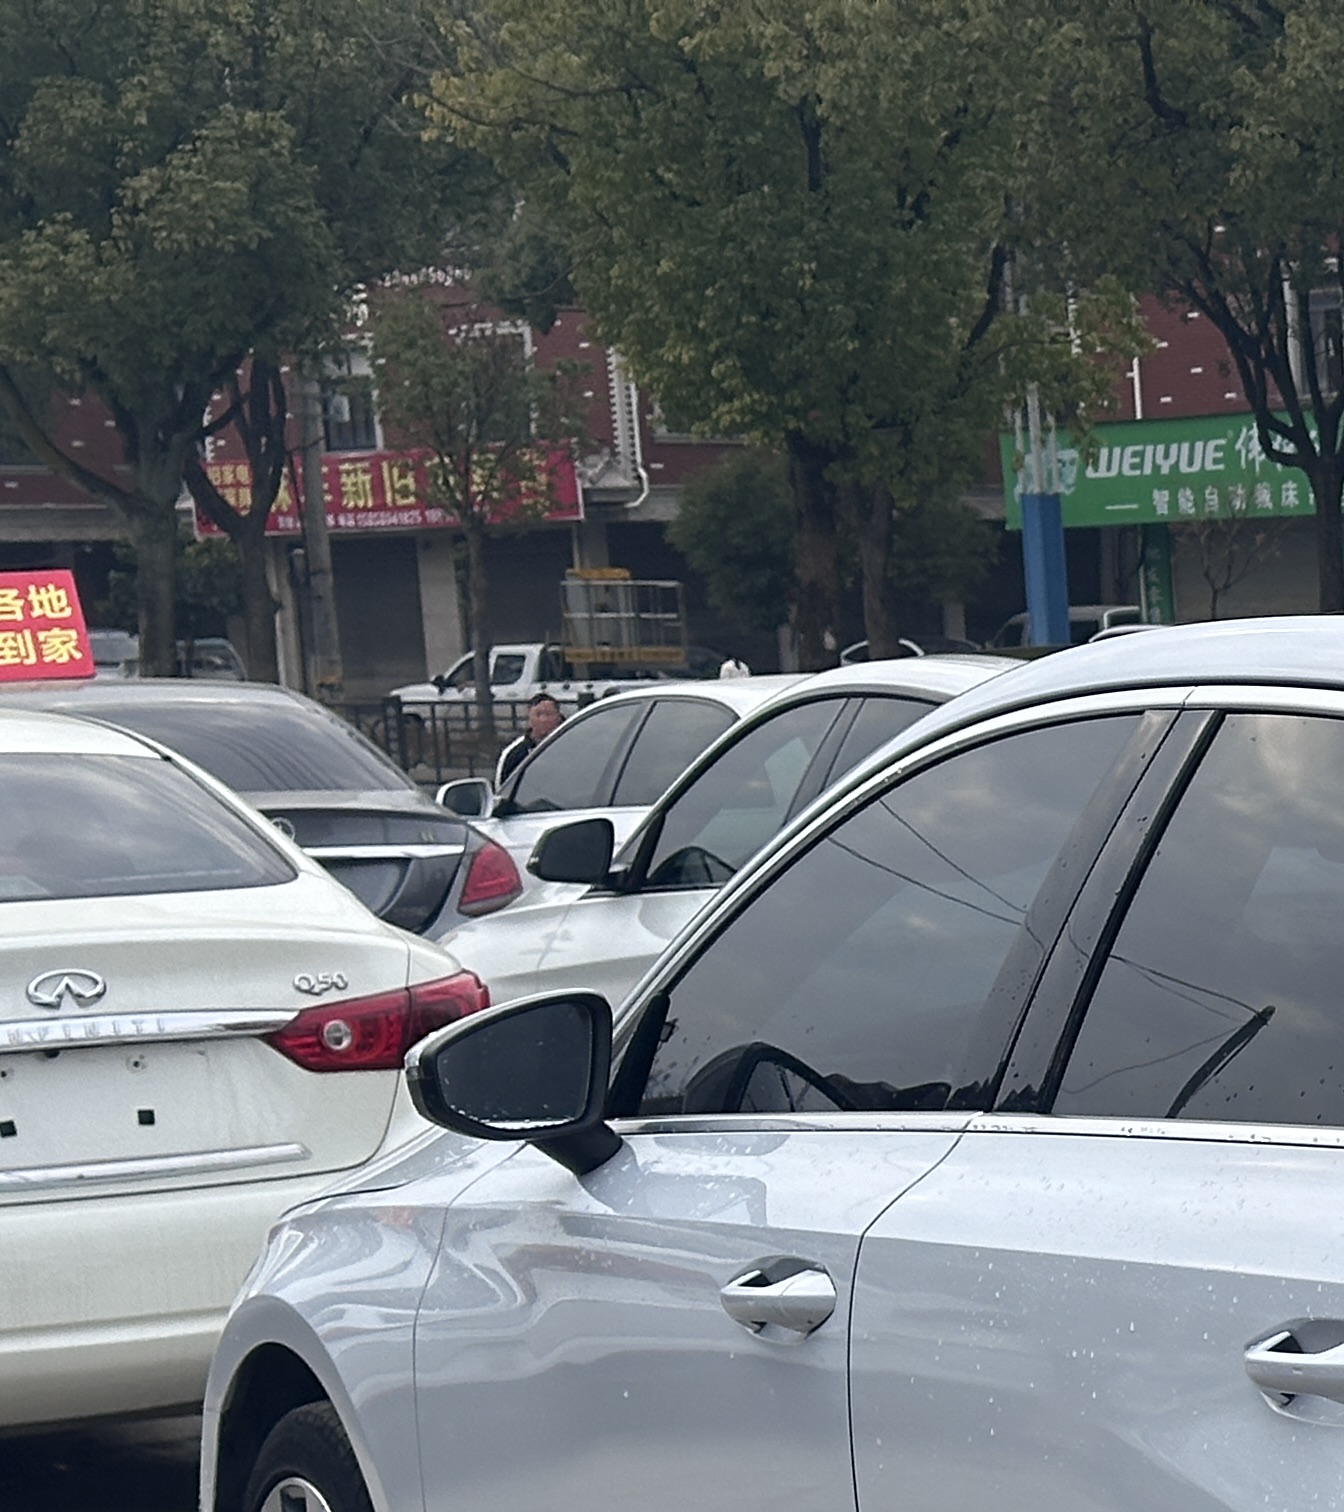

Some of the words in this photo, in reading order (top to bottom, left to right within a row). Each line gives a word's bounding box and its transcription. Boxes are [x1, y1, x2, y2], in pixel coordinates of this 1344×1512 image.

[1085, 438, 1228, 478] WEIYUE
[0, 583, 72, 621] 各地
[0, 627, 82, 665] 到家
[293, 972, 348, 996] Q50
